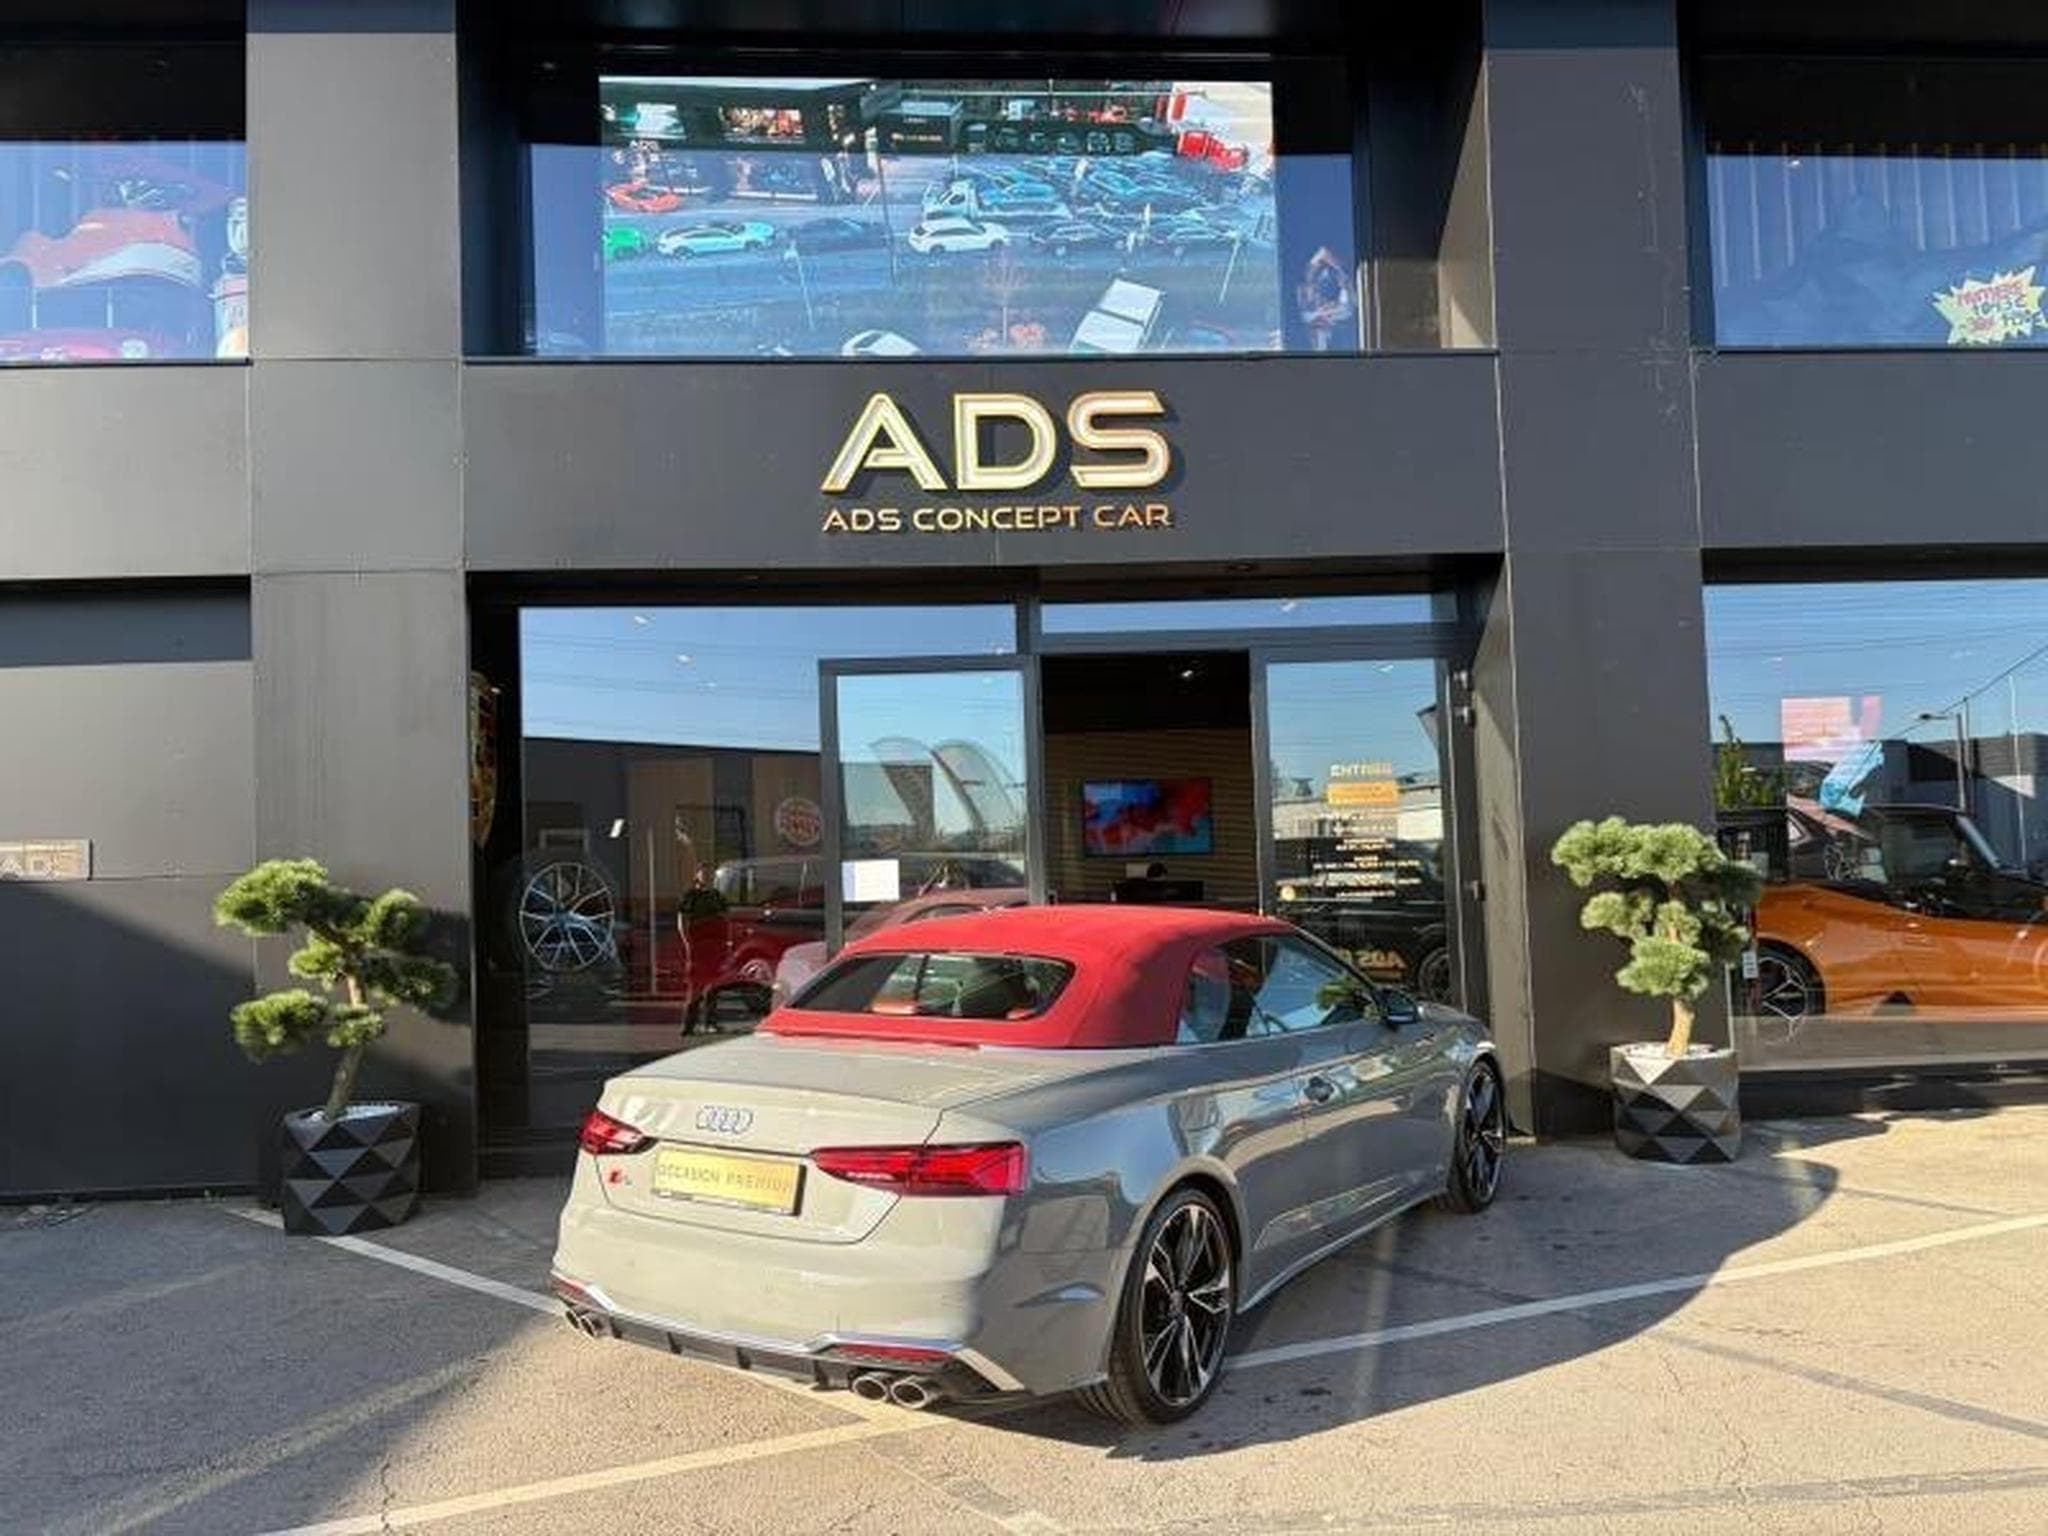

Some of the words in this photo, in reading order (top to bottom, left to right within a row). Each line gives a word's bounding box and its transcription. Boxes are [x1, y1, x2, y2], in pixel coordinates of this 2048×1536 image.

[820, 390, 1172, 493] ADS
[822, 507, 902, 532] ADS
[912, 505, 1082, 530] CONCEPT
[1093, 503, 1173, 528] CAR
